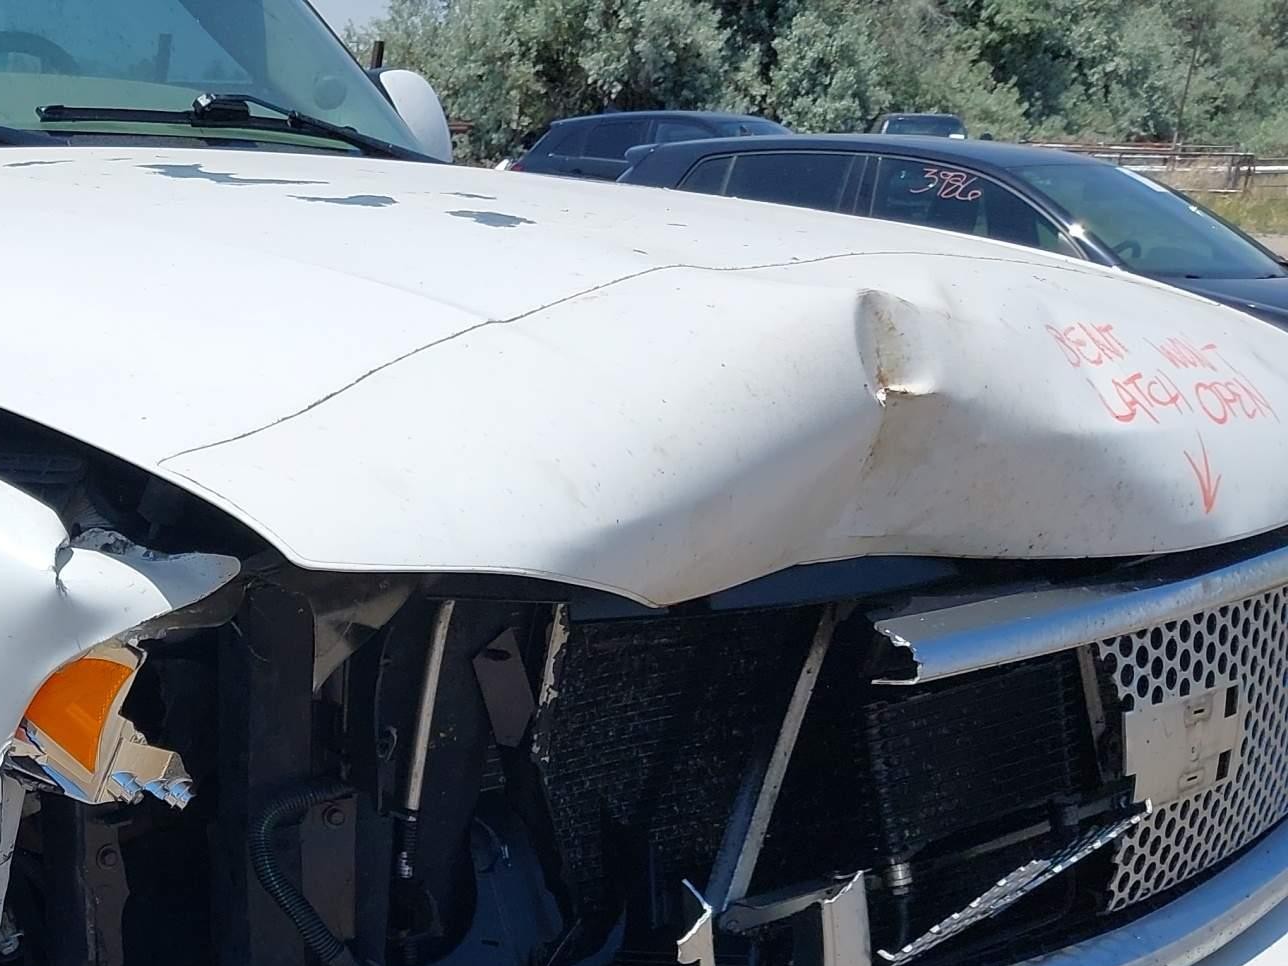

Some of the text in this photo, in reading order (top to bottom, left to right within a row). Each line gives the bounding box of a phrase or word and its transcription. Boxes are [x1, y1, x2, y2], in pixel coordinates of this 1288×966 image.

[909, 167, 982, 201] 3986
[1044, 322, 1129, 368] BENT
[1086, 369, 1281, 425] LATCH OPEN
